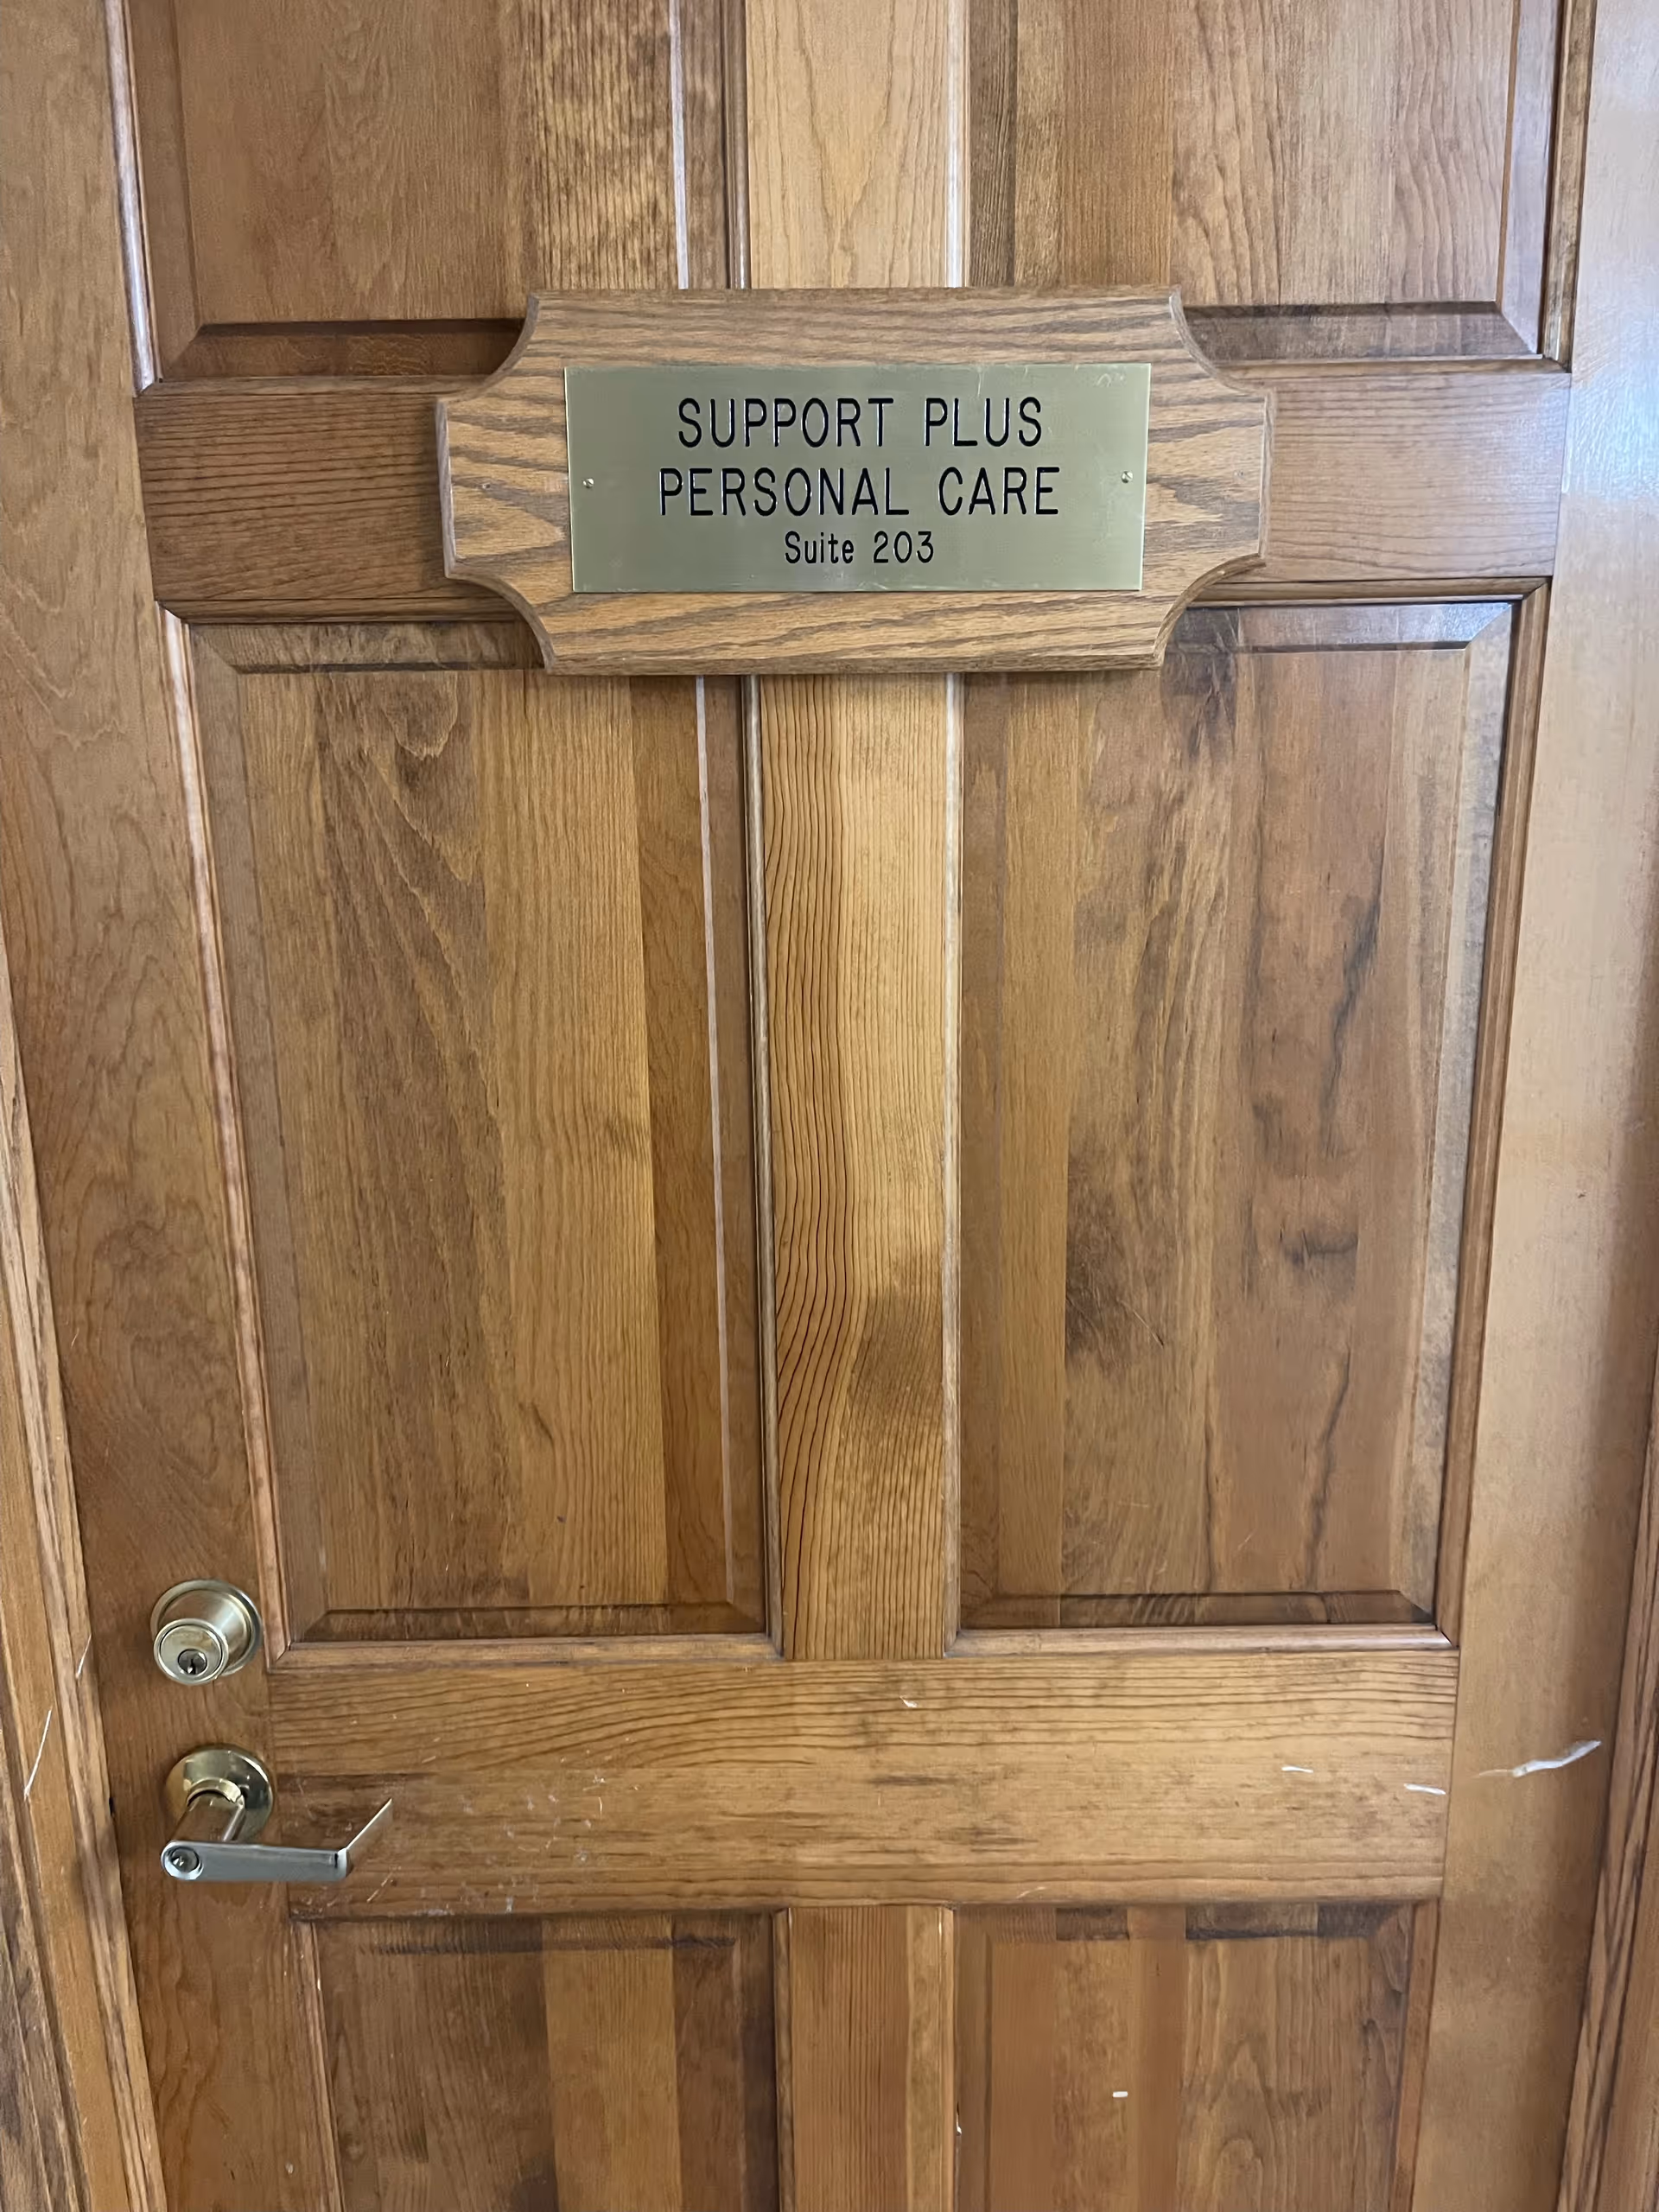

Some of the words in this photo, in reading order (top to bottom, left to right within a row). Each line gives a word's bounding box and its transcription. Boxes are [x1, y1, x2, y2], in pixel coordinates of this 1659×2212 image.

[678, 397, 894, 448] SUPPORT
[925, 397, 1042, 448] PLUS
[658, 467, 910, 517] PERSONAL
[938, 466, 1060, 516] CARE
[785, 530, 855, 564] Suite
[873, 530, 934, 564] 203
